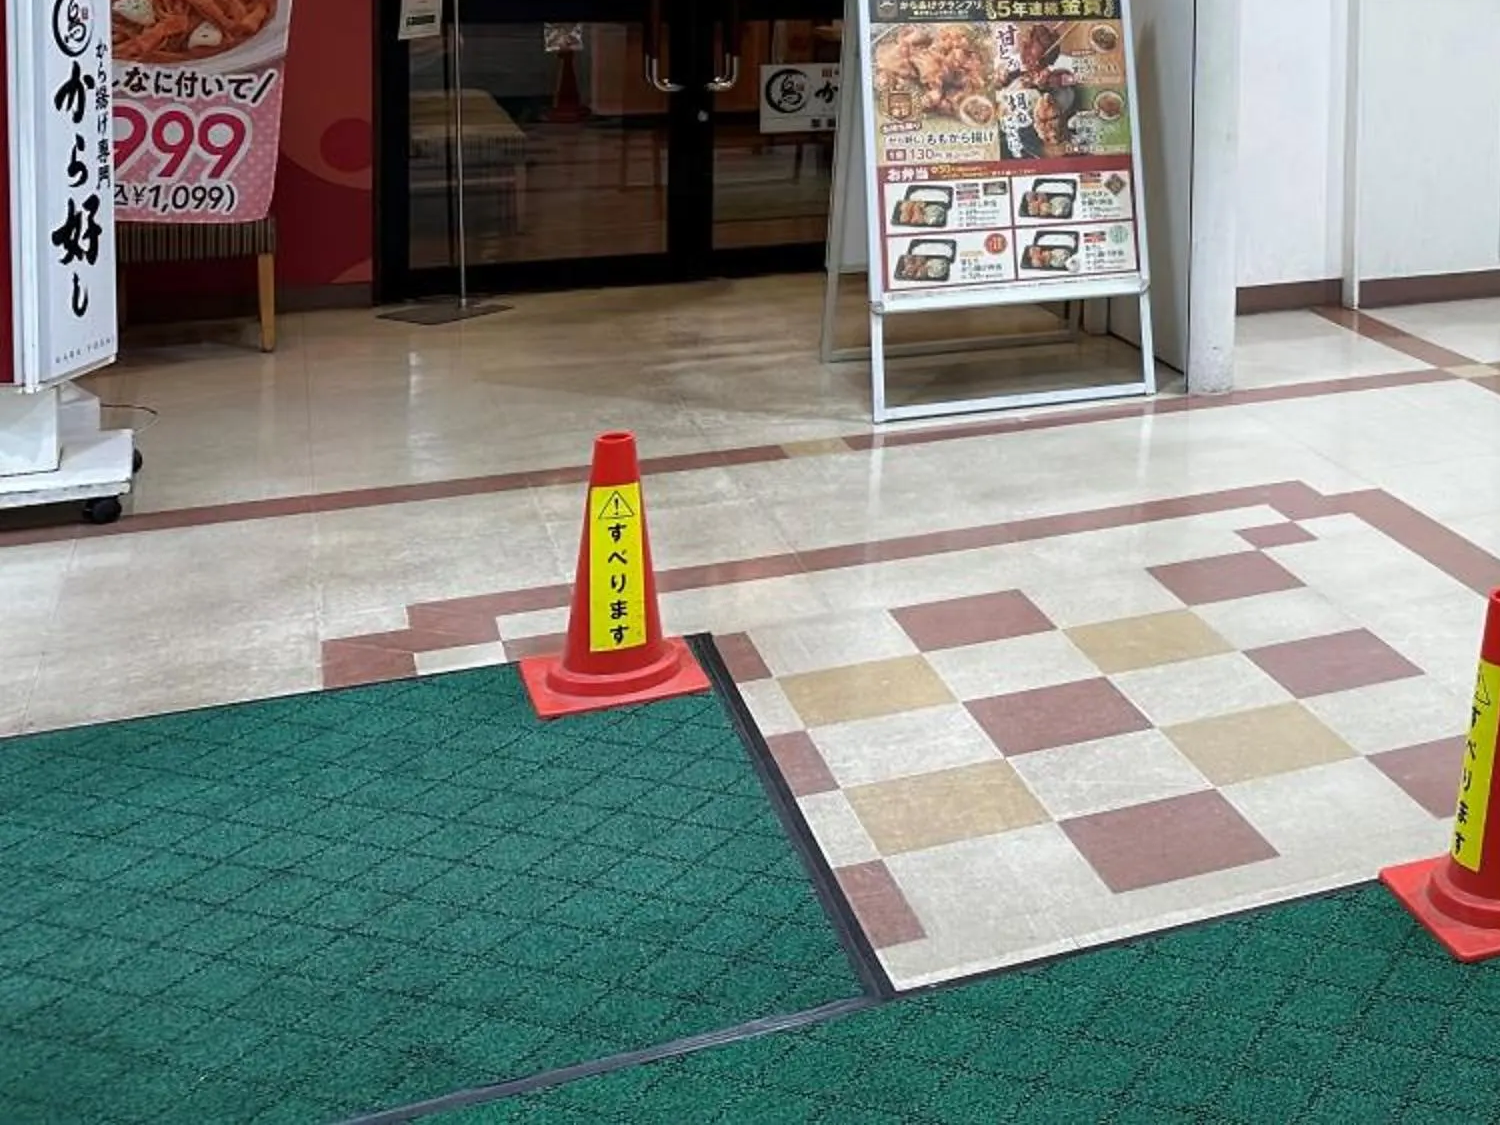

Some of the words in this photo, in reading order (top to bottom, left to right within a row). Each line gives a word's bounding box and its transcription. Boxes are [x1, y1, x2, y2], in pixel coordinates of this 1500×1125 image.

[112, 67, 254, 99] なに付いて
[52, 61, 102, 317] から好し
[607, 522, 629, 645] すべります
